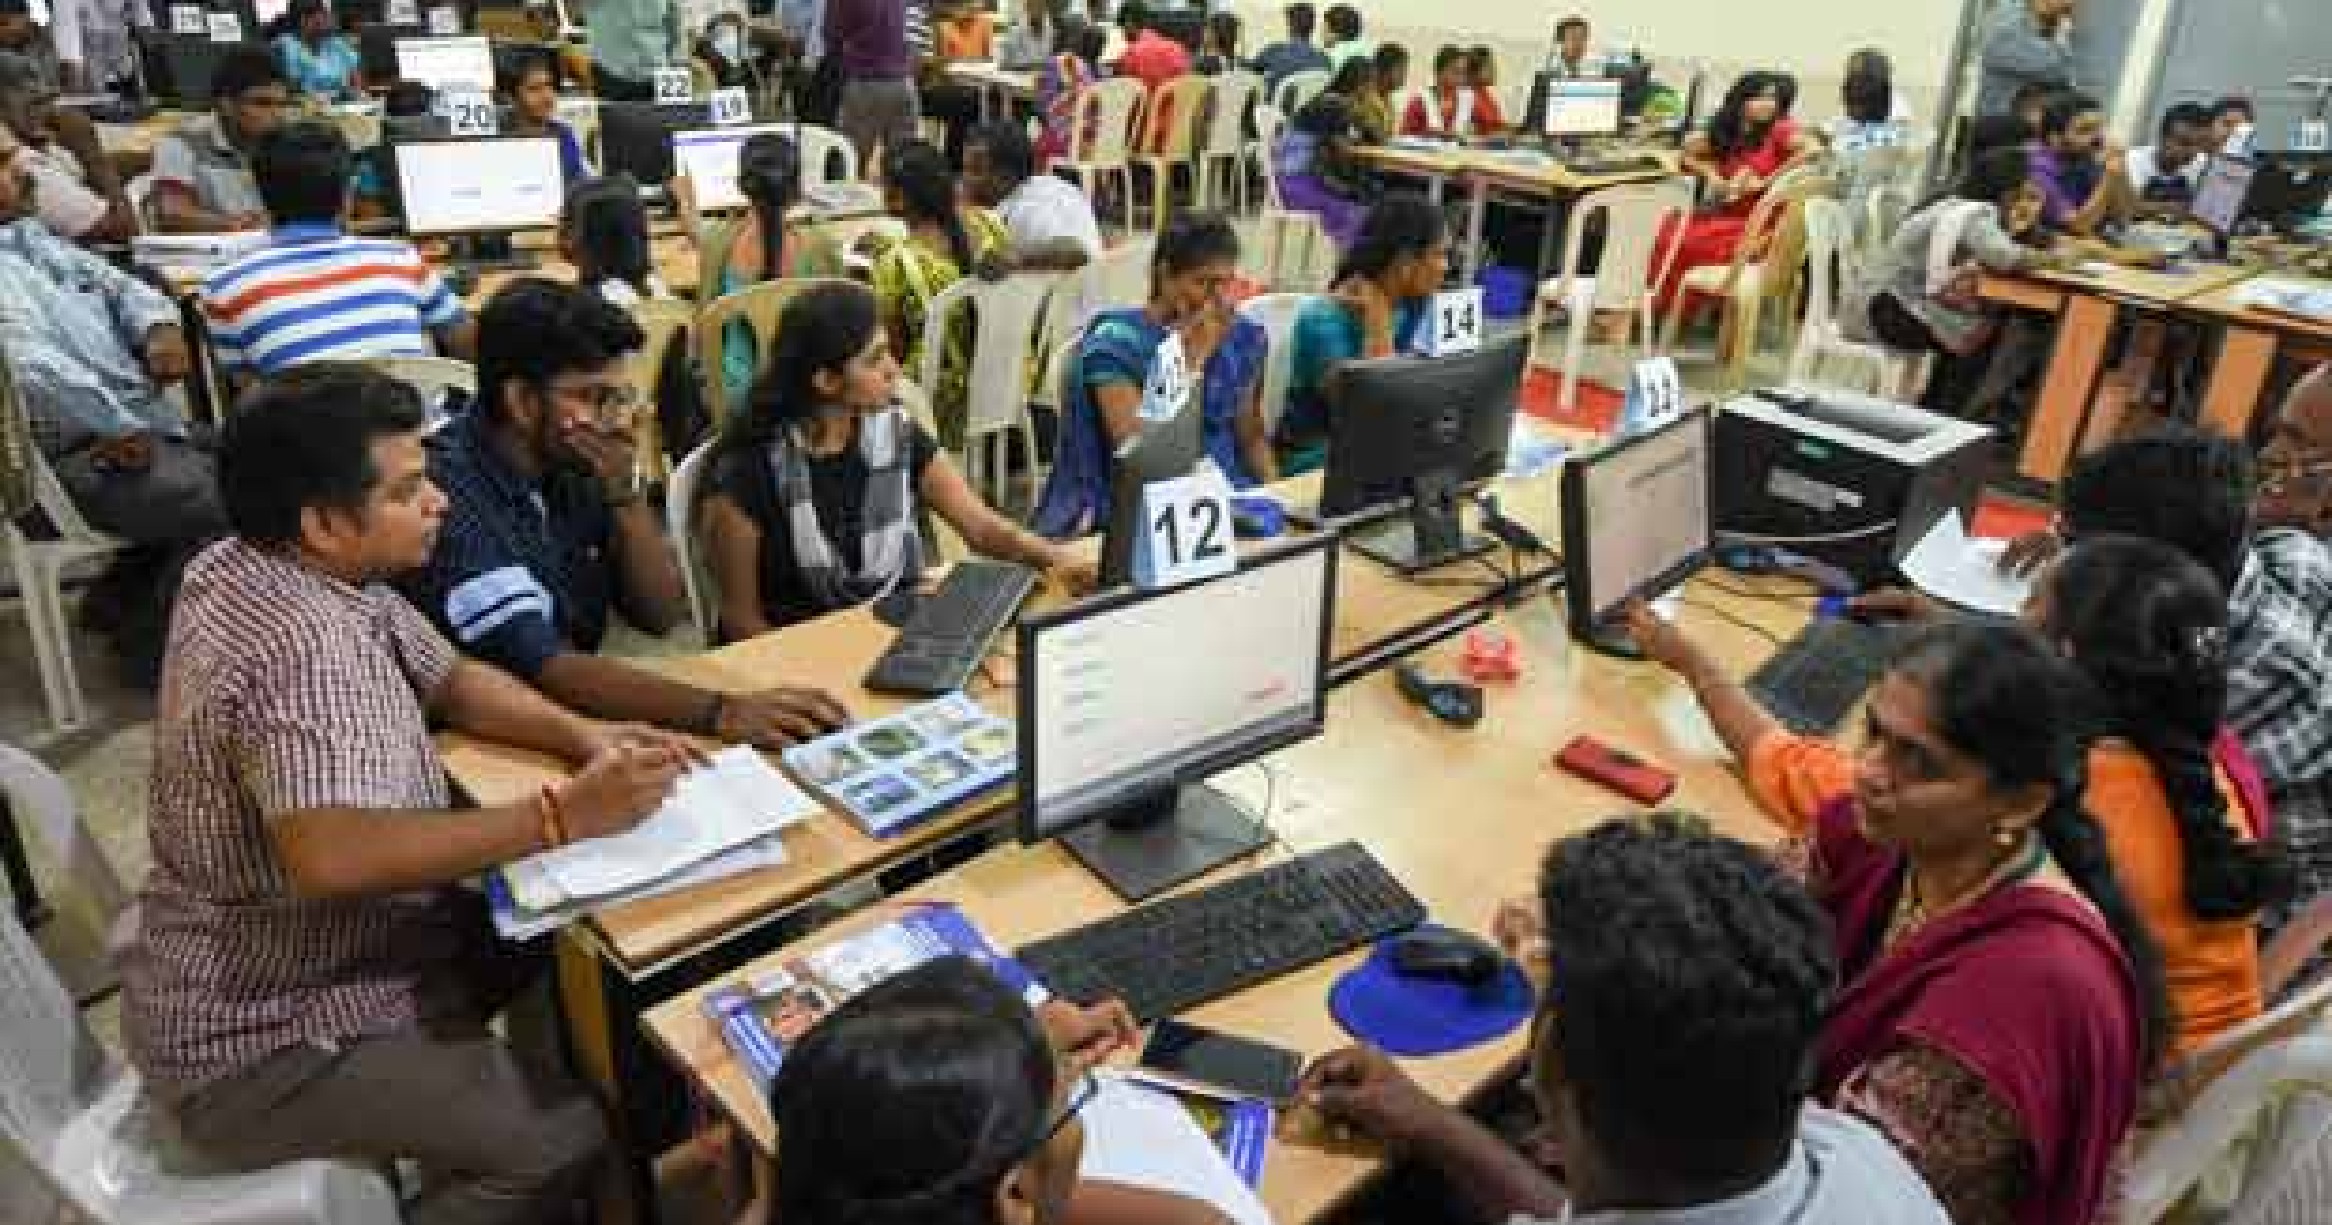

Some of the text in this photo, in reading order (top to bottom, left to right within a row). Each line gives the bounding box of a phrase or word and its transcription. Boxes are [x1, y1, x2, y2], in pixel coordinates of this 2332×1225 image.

[660, 75, 689, 97] 22
[456, 104, 490, 128] 20
[1442, 304, 1475, 339] 14
[1154, 496, 1225, 565] 12
